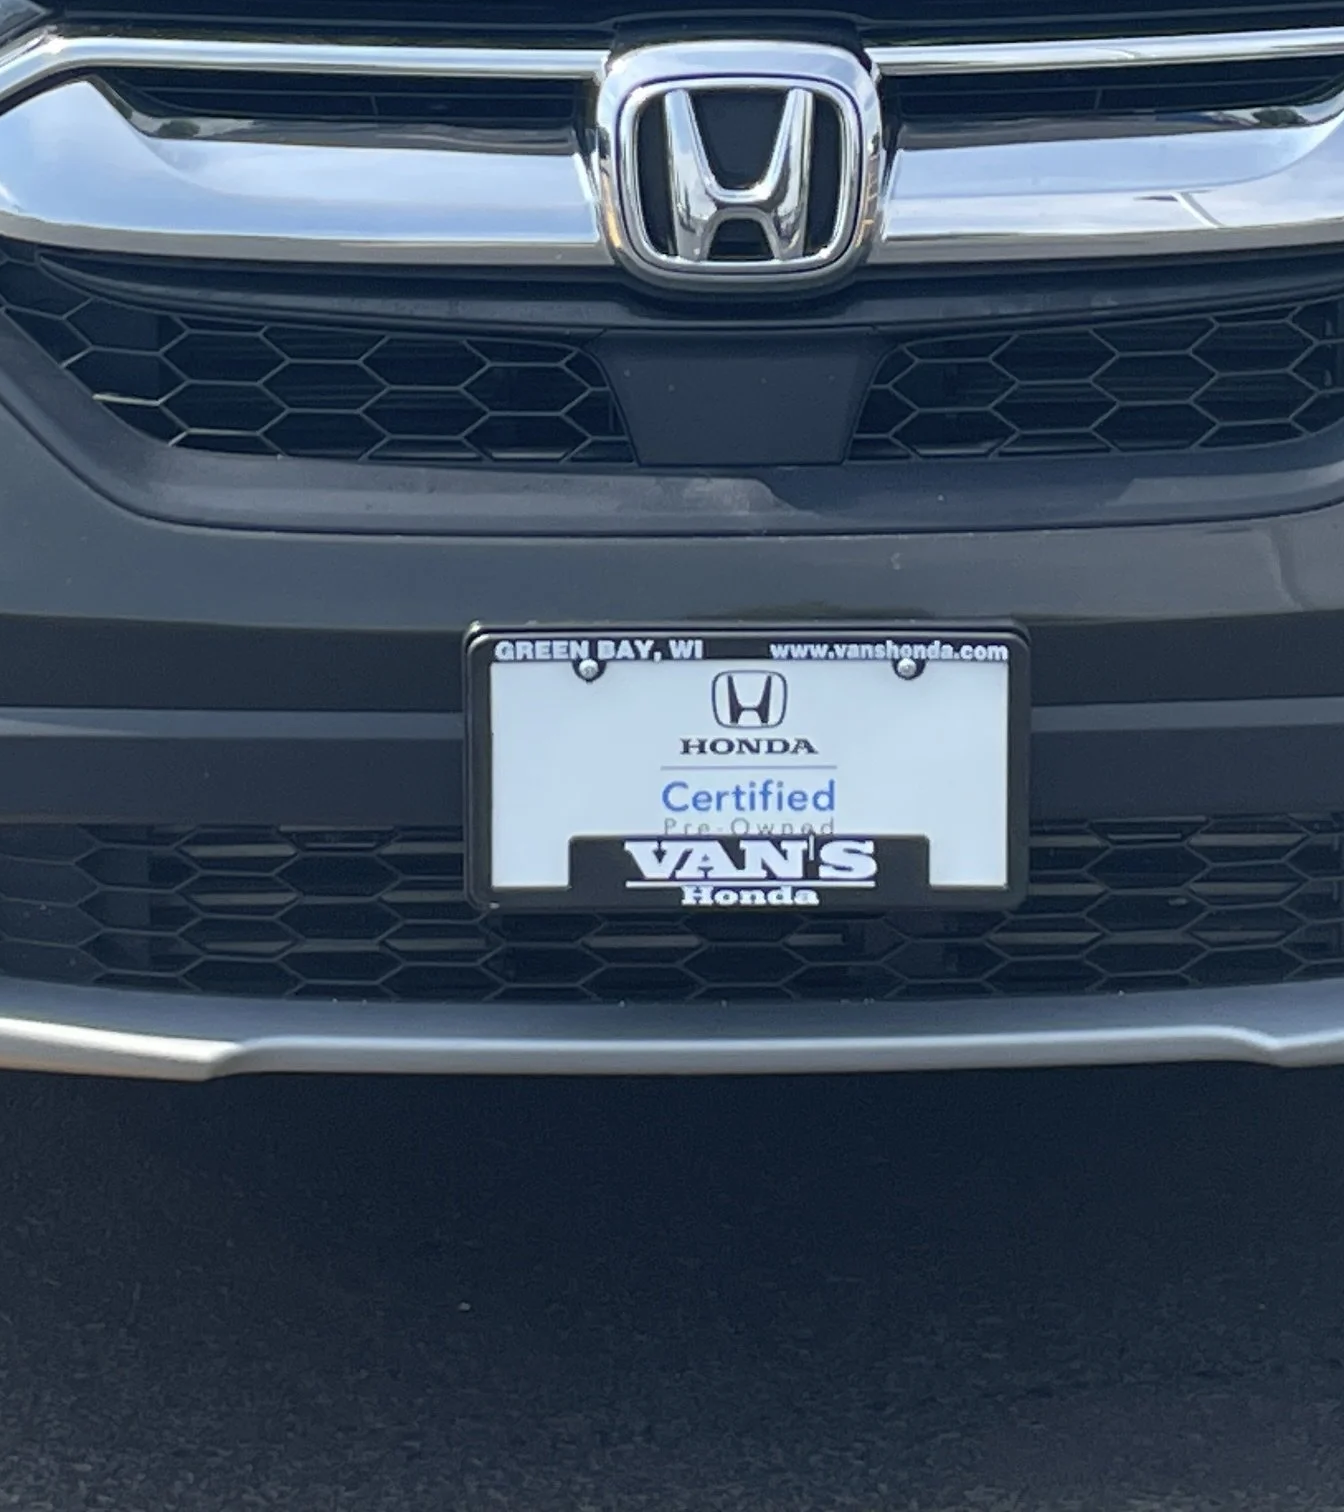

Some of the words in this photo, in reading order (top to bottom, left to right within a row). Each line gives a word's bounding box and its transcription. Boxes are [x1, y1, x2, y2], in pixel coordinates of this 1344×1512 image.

[494, 640, 590, 660] GREEN
[597, 640, 662, 663] BAY,
[669, 639, 704, 659] WI
[769, 639, 1009, 661] www.vanshonda.com
[680, 738, 819, 755] HONDA
[662, 778, 836, 813] Certified
[623, 834, 878, 880] VAN'S
[681, 886, 820, 906] Honda
